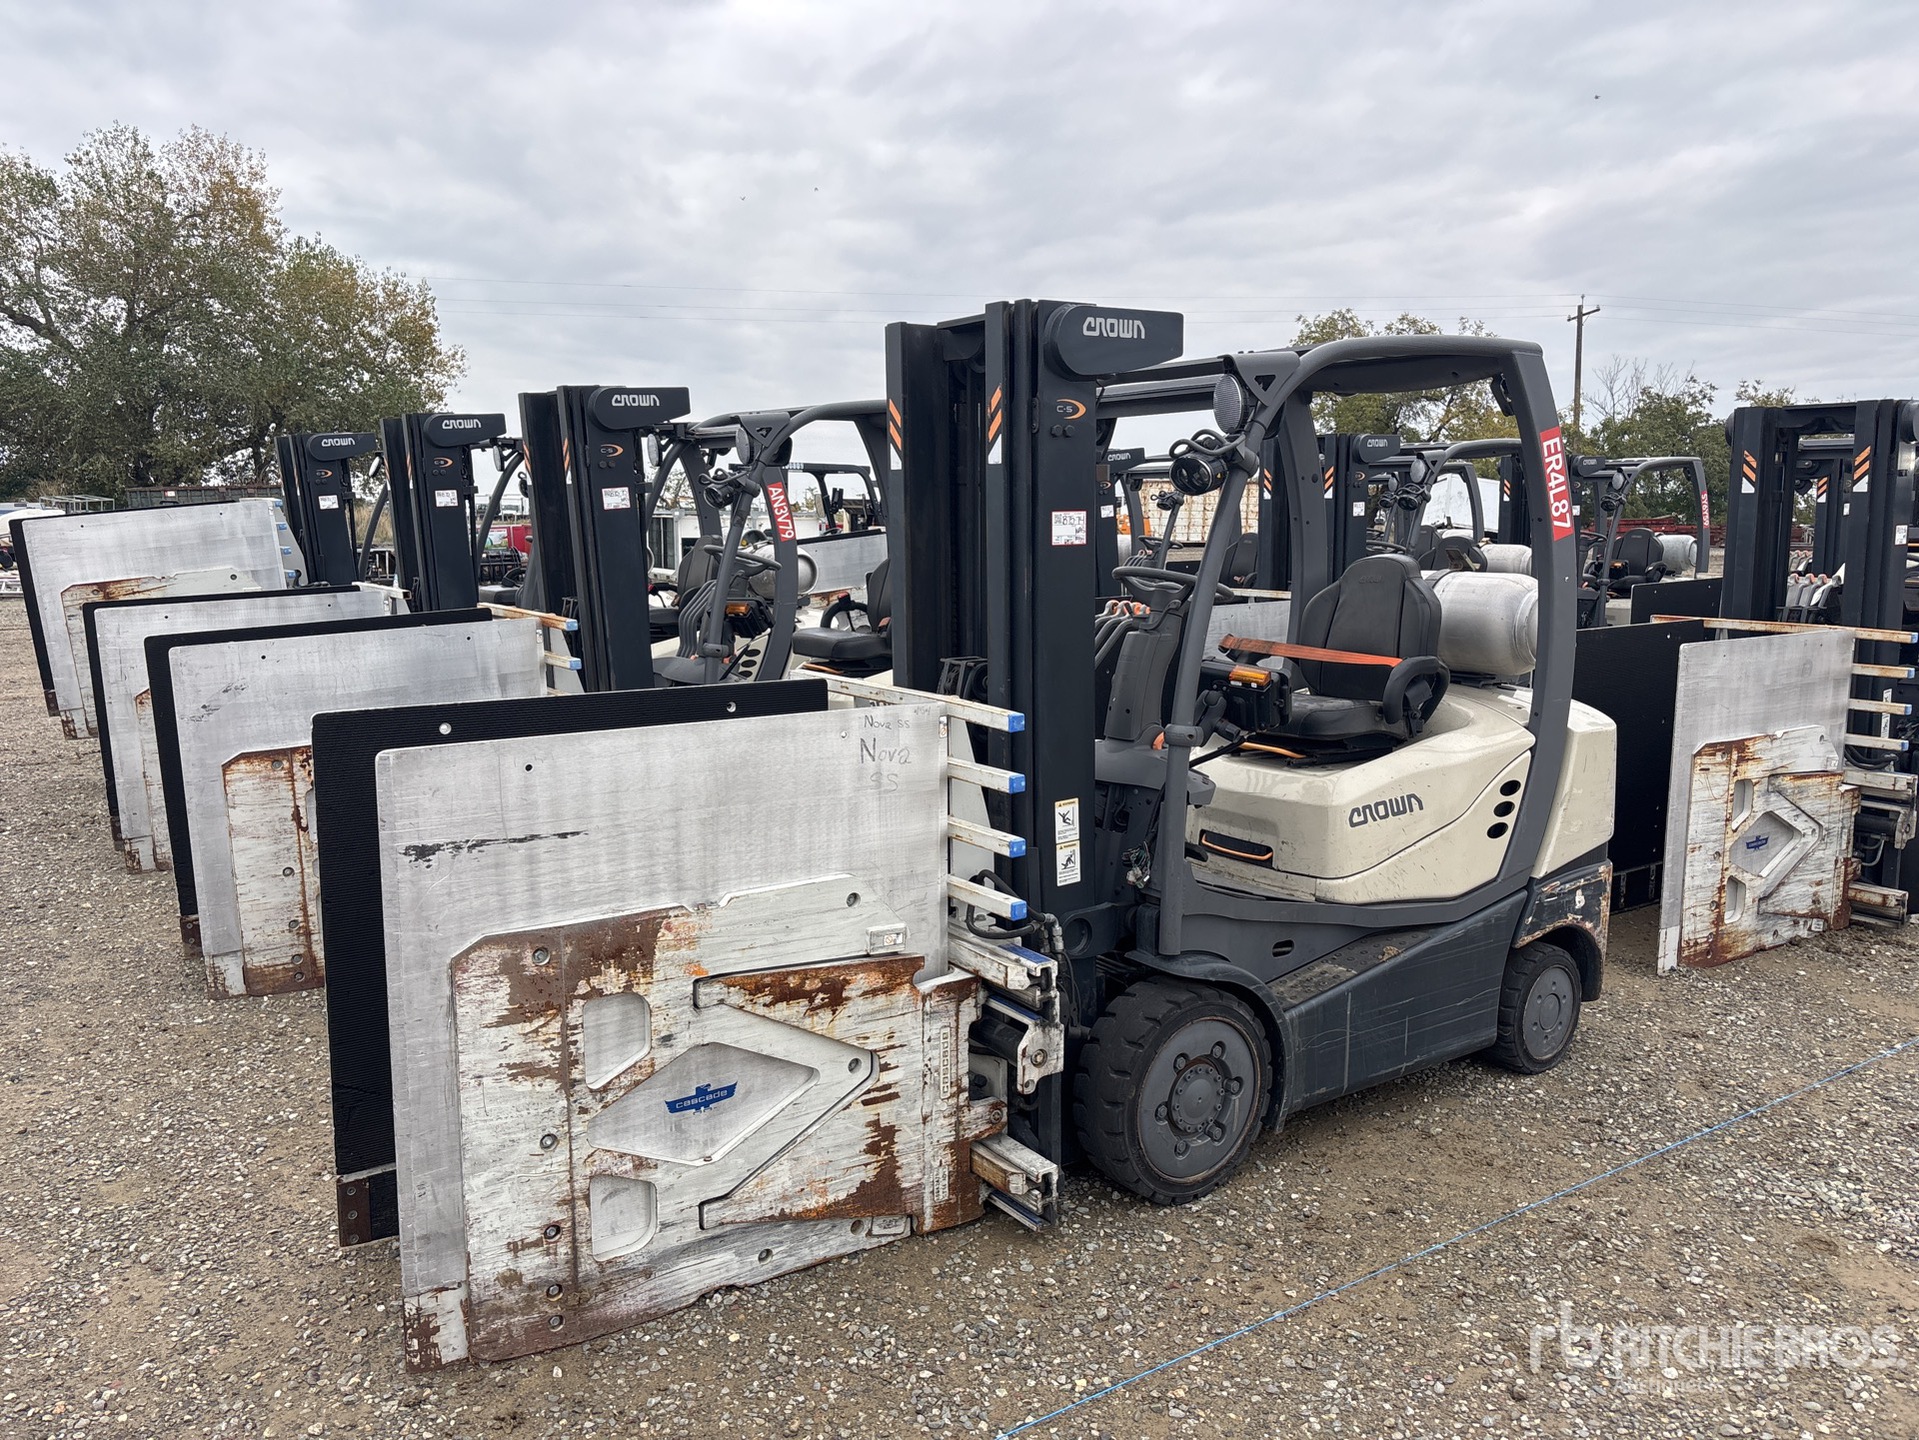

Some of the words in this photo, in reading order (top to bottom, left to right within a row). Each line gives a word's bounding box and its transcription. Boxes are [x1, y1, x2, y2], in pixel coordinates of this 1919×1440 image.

[1082, 316, 1145, 339] CROWN
[611, 394, 660, 407] CROWN
[442, 418, 481, 430] CROWN
[321, 438, 355, 447] CROWN
[1367, 439, 1388, 448] CROWN
[1542, 436, 1571, 529] ER4L87
[769, 486, 795, 540] AN3V79
[1348, 793, 1424, 828] CROWN
[675, 1089, 728, 1109] cascade
